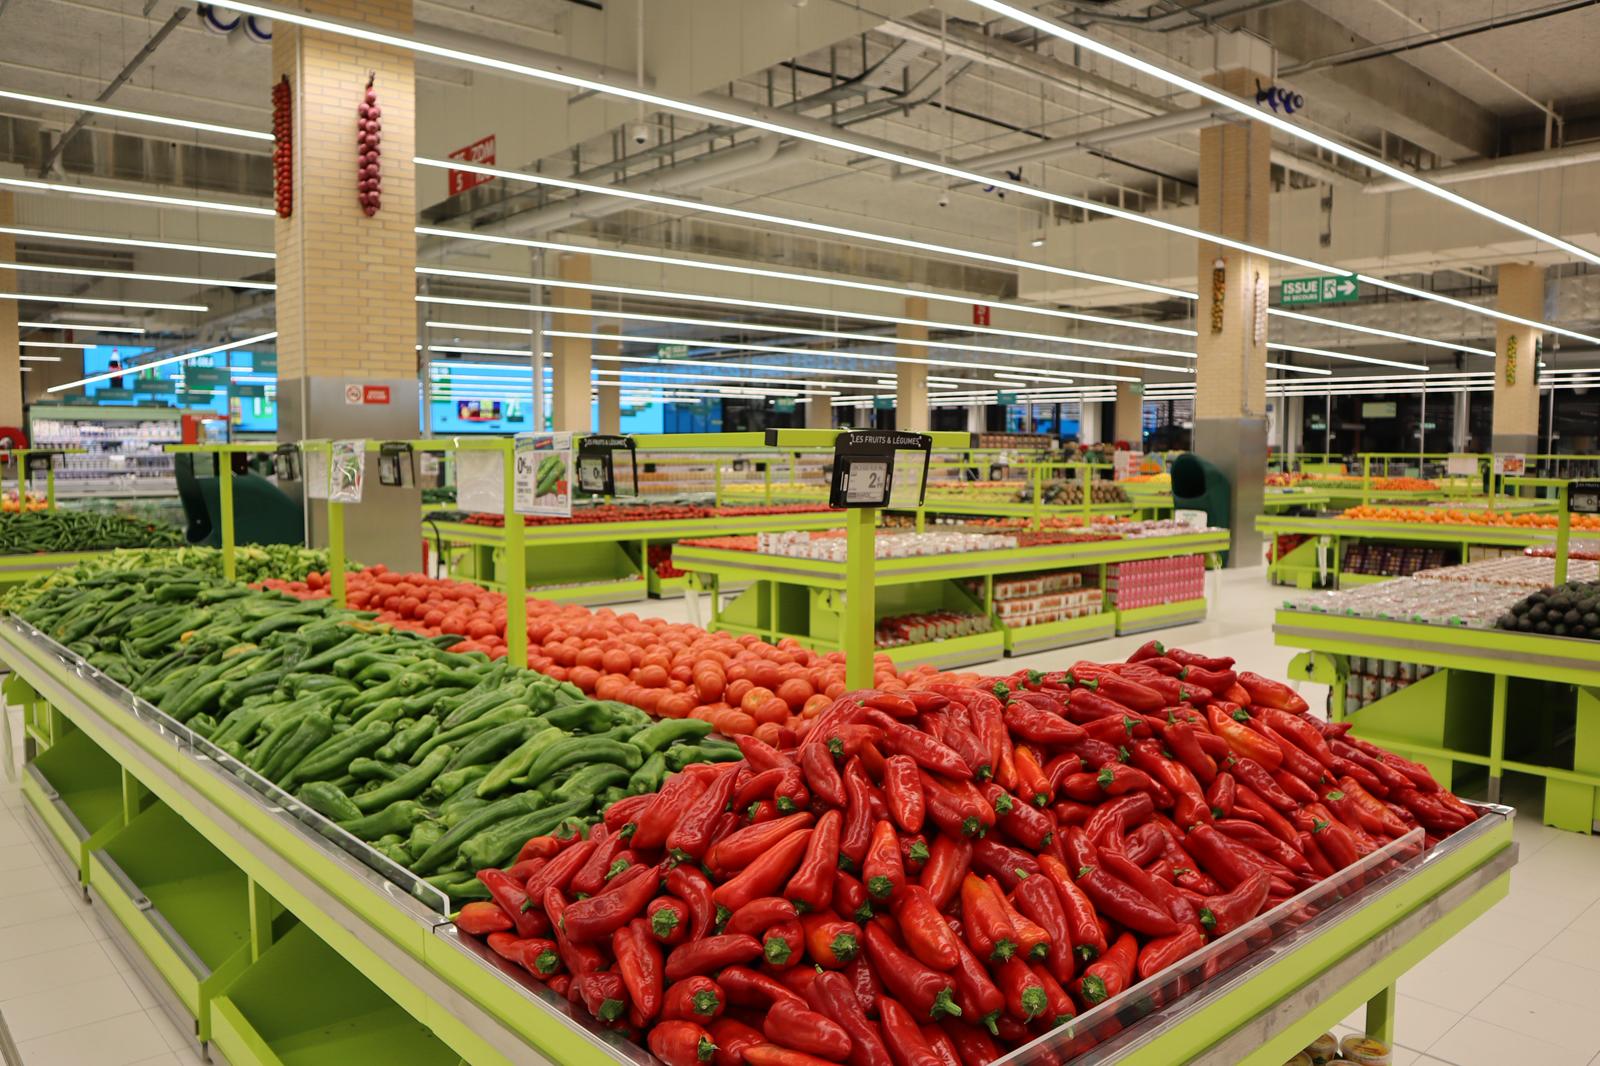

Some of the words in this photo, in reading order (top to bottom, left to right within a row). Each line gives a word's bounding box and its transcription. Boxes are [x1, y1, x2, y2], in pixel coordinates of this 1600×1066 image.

[1284, 281, 1318, 293] ISSUE
[865, 436, 886, 444] FRUITS
[892, 436, 919, 445] LÉGUMES
